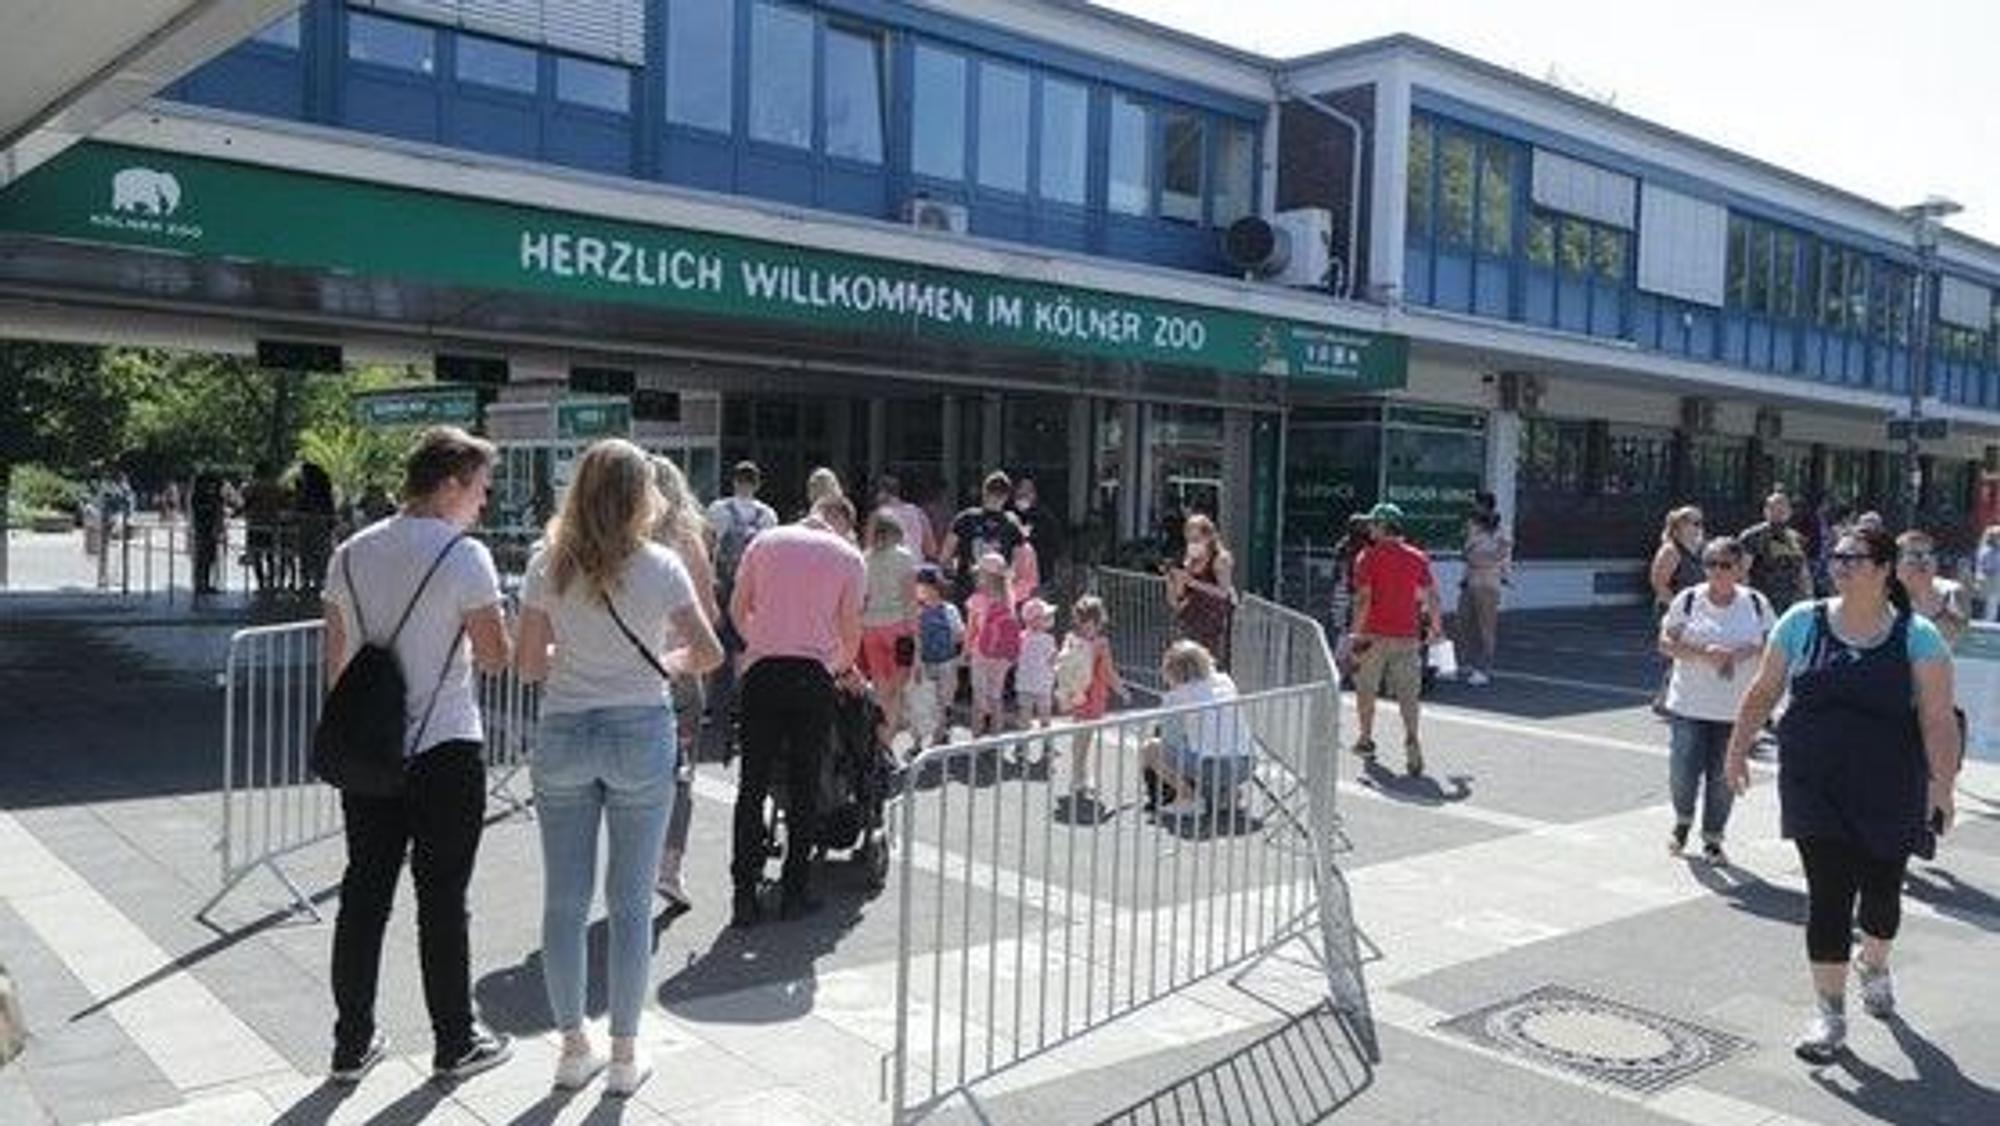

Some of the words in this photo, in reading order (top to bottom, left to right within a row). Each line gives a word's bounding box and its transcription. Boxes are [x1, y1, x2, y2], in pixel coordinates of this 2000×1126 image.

[521, 230, 722, 291] HERZLICH
[742, 260, 973, 323] WILLKOMMEN
[988, 295, 1022, 328] IM
[1035, 295, 1141, 342] KÖLNER
[1154, 315, 1206, 350] ZOO
